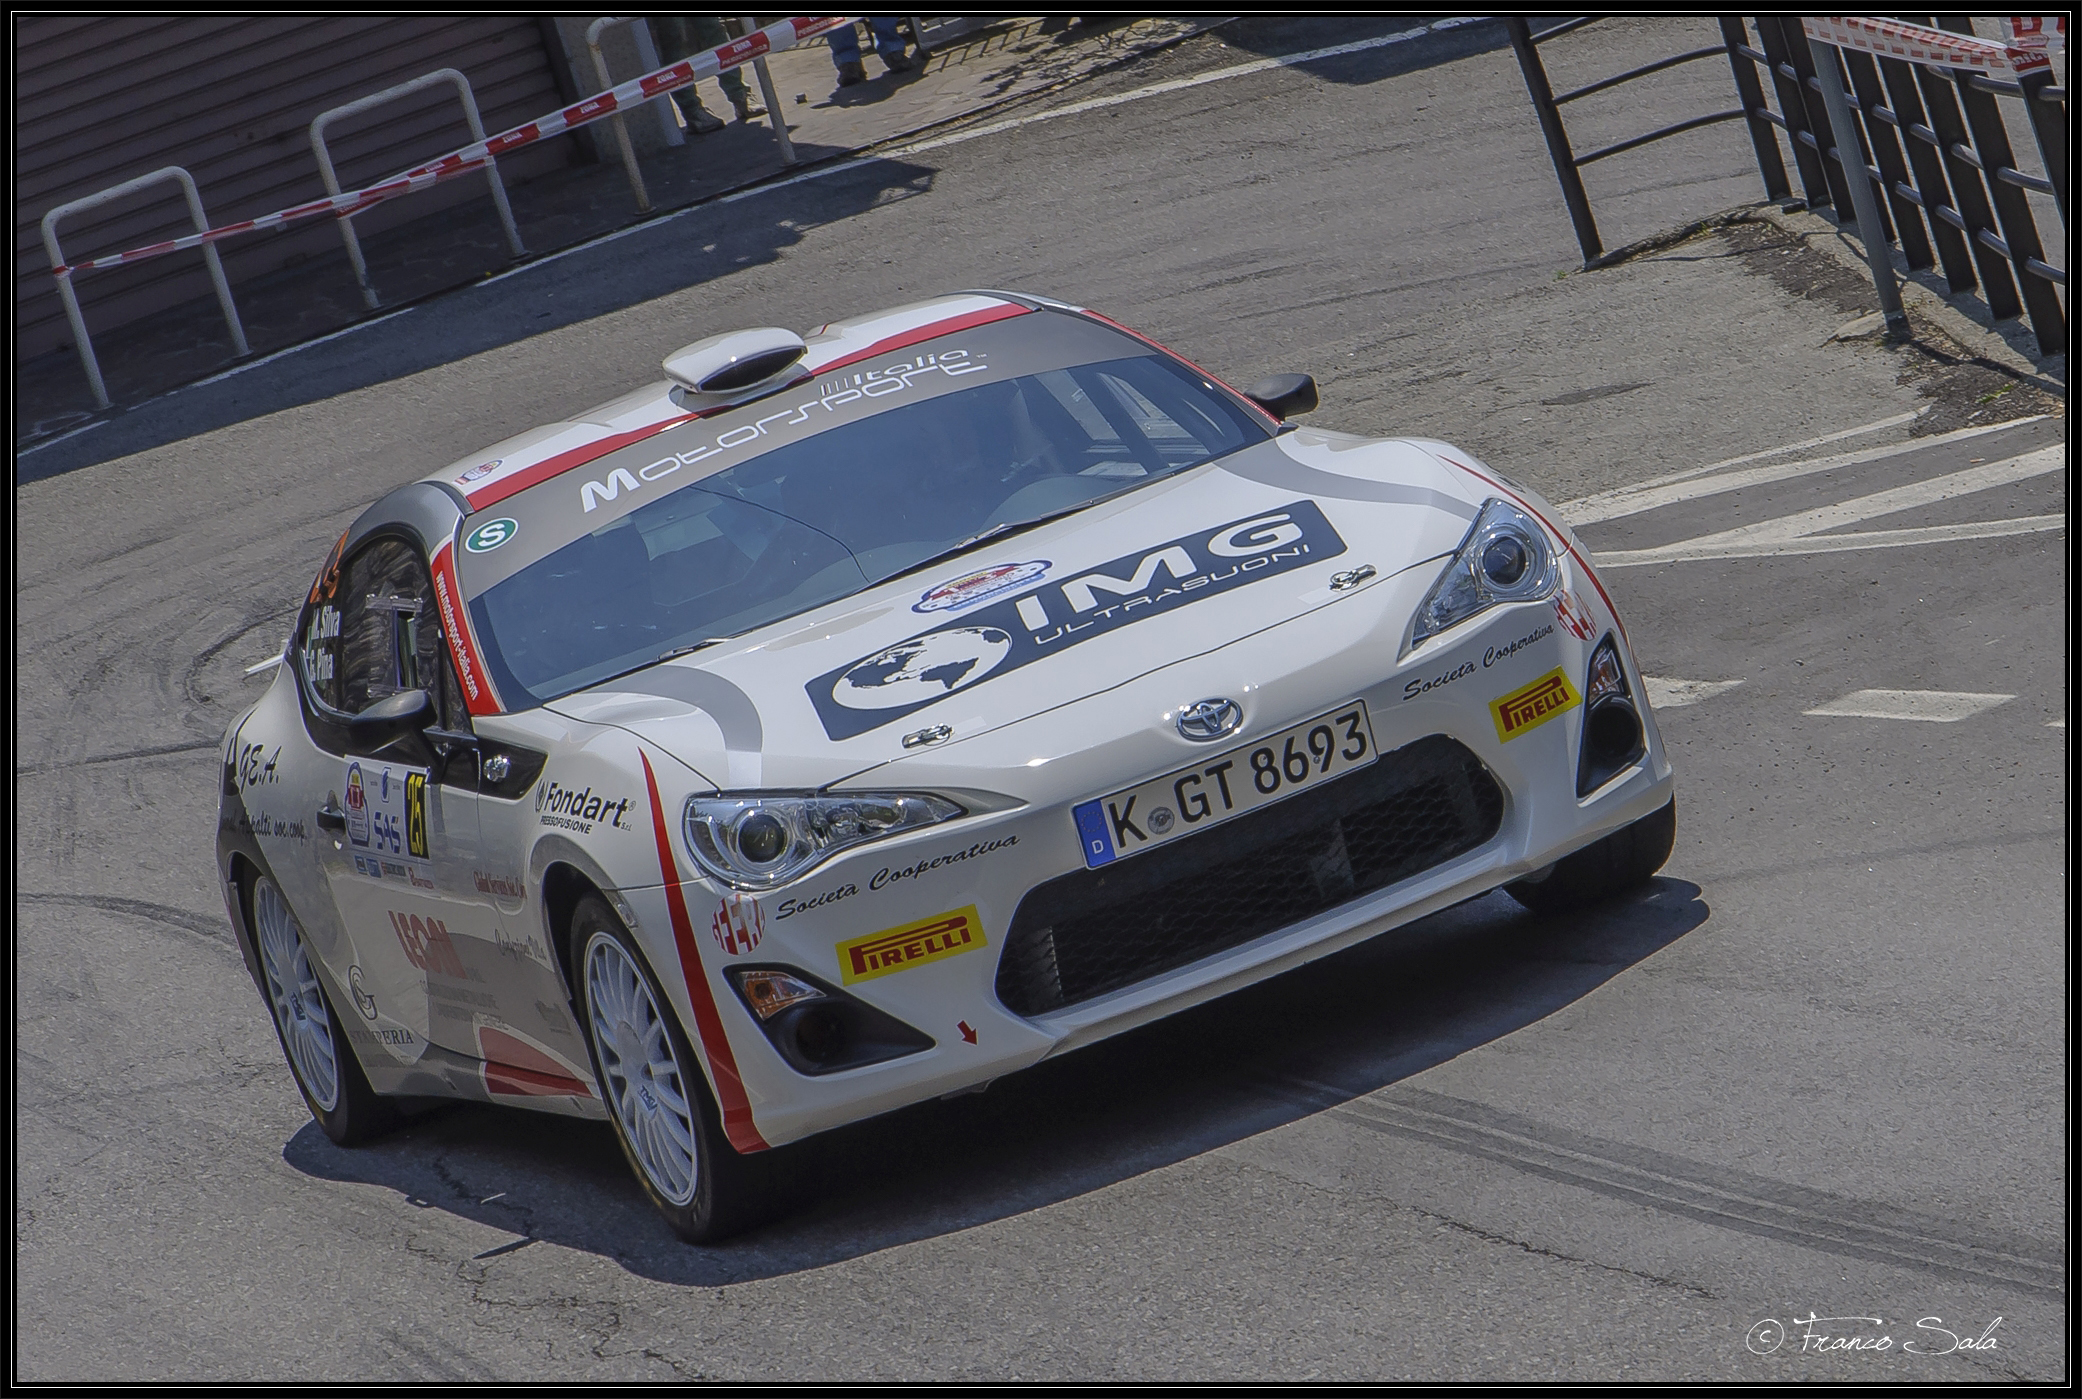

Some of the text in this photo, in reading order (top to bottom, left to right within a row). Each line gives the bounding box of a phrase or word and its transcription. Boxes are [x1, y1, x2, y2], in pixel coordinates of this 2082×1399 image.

[732, 40, 752, 53] ZONA
[853, 349, 969, 386] Italia
[1014, 514, 1303, 632] IMG
[1034, 545, 1310, 645] ULTRASUONI
[436, 571, 478, 701] www.motorsport-italia.com
[1402, 623, 1555, 701] Società Cooperativa
[1499, 676, 1571, 733] PIRELLI
[1108, 710, 1368, 848] K GT 8693
[540, 815, 592, 834] PRESSOFUSIONE
[1092, 840, 1104, 854] D
[775, 834, 1020, 920] Società Cooperativa
[848, 915, 972, 976] PIRELLI
